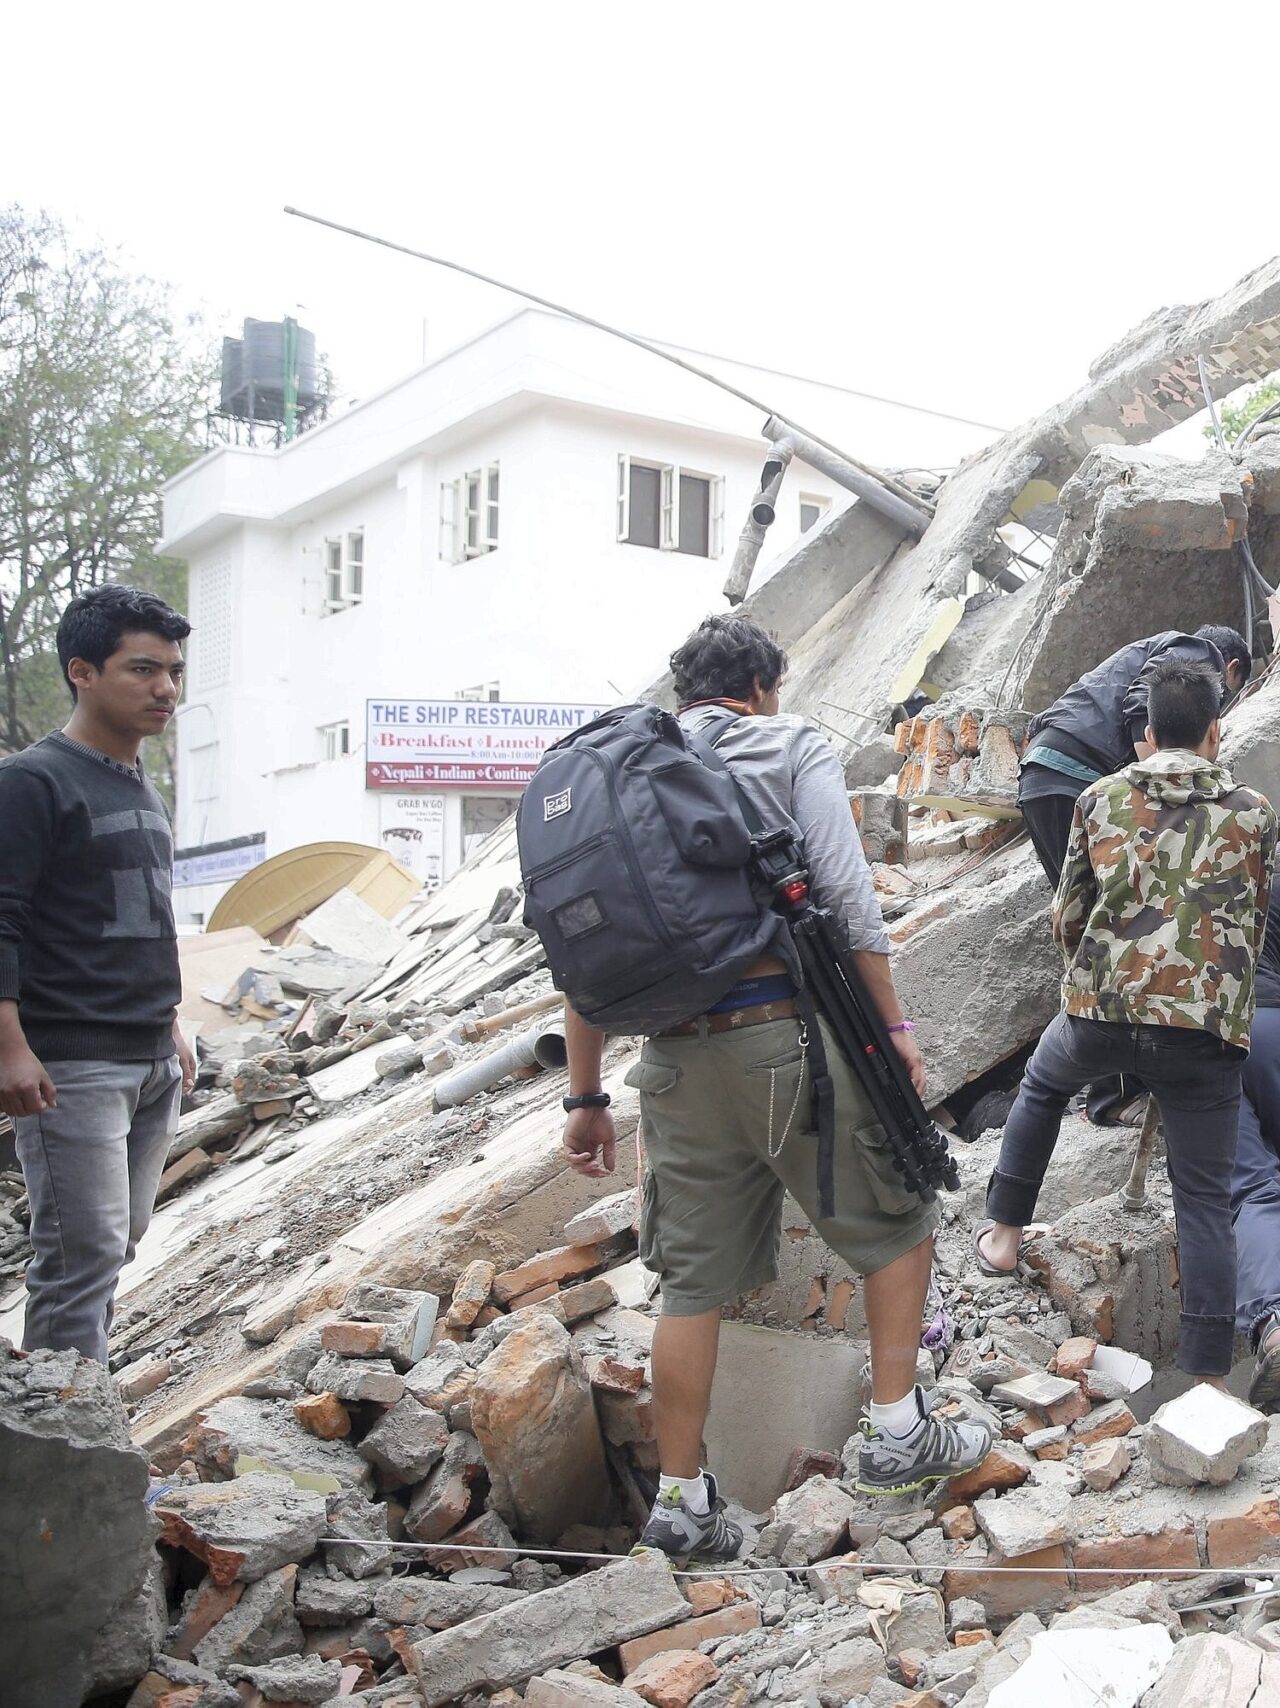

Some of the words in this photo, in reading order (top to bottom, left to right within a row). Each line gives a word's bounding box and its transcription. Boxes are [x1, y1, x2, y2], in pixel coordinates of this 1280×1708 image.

[372, 705, 409, 723] THE
[416, 706, 458, 724] SHIP
[465, 707, 584, 727] RESTAURANT
[380, 733, 473, 748] Breakfast
[485, 735, 545, 749] Lunch
[381, 764, 424, 783] Nepali
[433, 766, 476, 780] Indian
[397, 799, 420, 809] GRAB
[547, 794, 568, 808] pro
[880, 1445, 912, 1458] SALOMON
